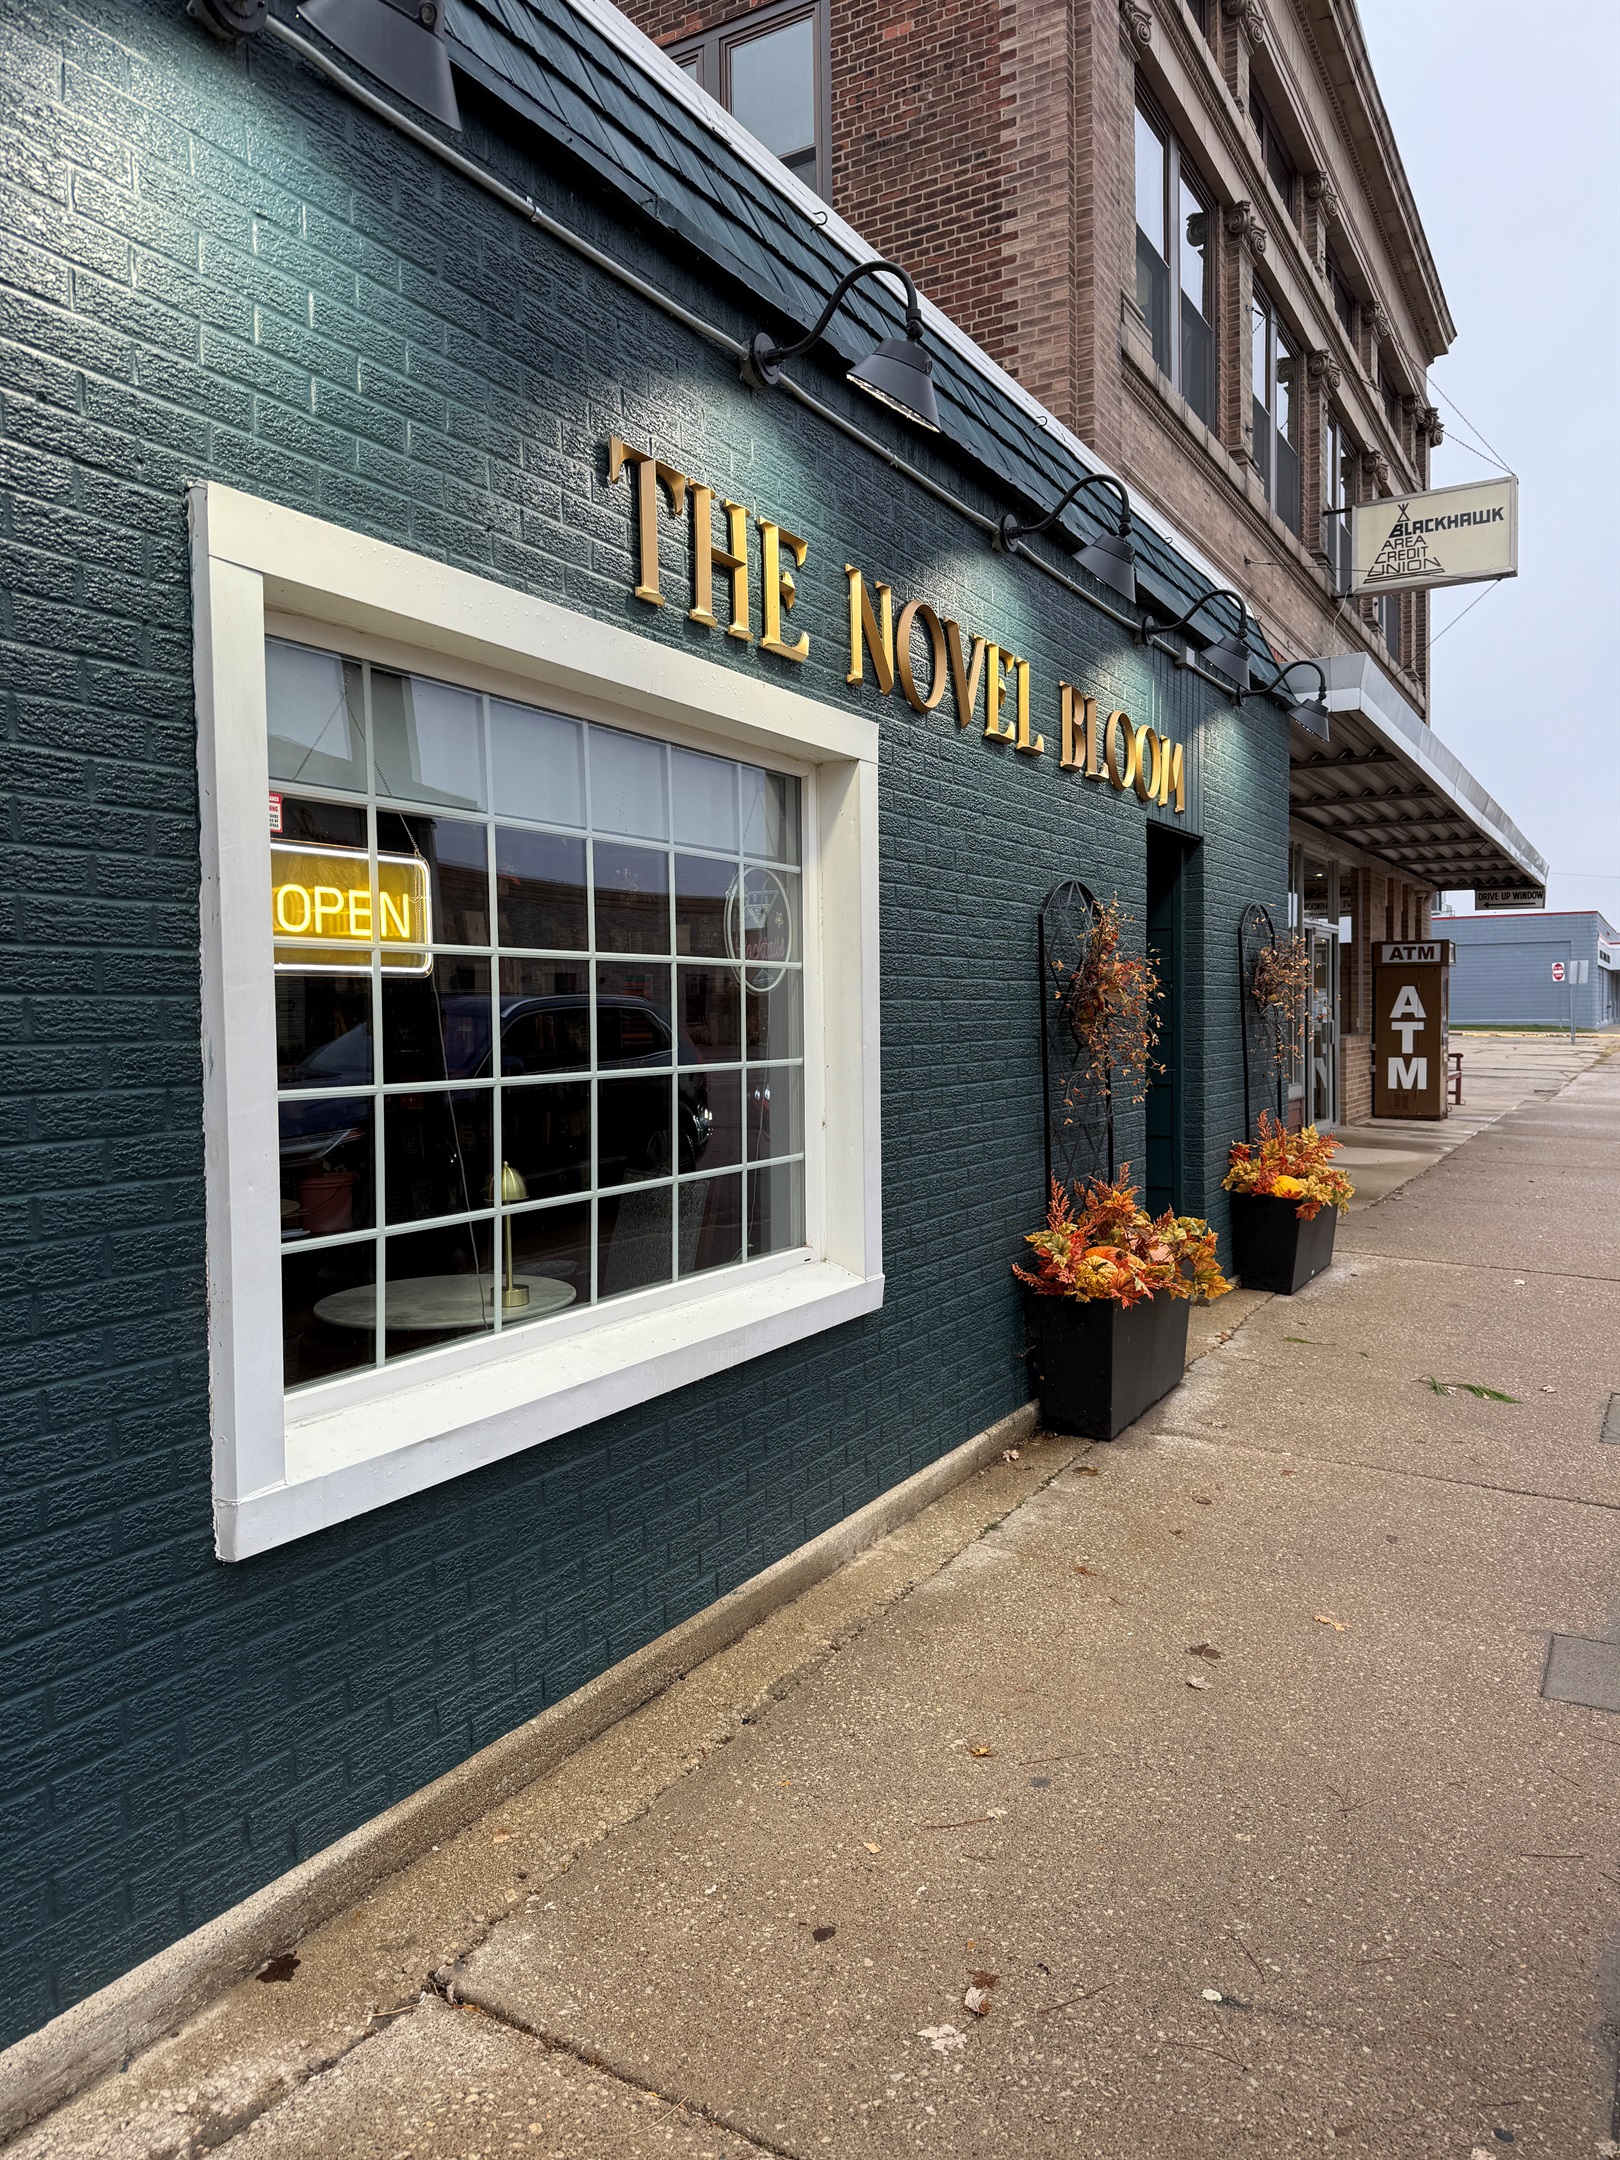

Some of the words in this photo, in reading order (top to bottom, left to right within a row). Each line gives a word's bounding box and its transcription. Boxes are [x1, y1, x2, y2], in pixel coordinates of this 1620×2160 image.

[1388, 506, 1505, 538] BLACKHAWK
[1381, 535, 1426, 551] AREA
[1374, 546, 1429, 565] CREDIT
[1367, 556, 1442, 577] UNION
[608, 435, 809, 662] THE
[845, 563, 1045, 757] NOVEL
[1059, 680, 1185, 814] BLOOM
[1478, 892, 1499, 901] DRIVE
[1501, 891, 1511, 900] UP
[1512, 890, 1544, 900] WINDOW
[277, 883, 411, 939] OPEN
[1388, 945, 1435, 961] ATM
[1387, 985, 1428, 1090] ATM
